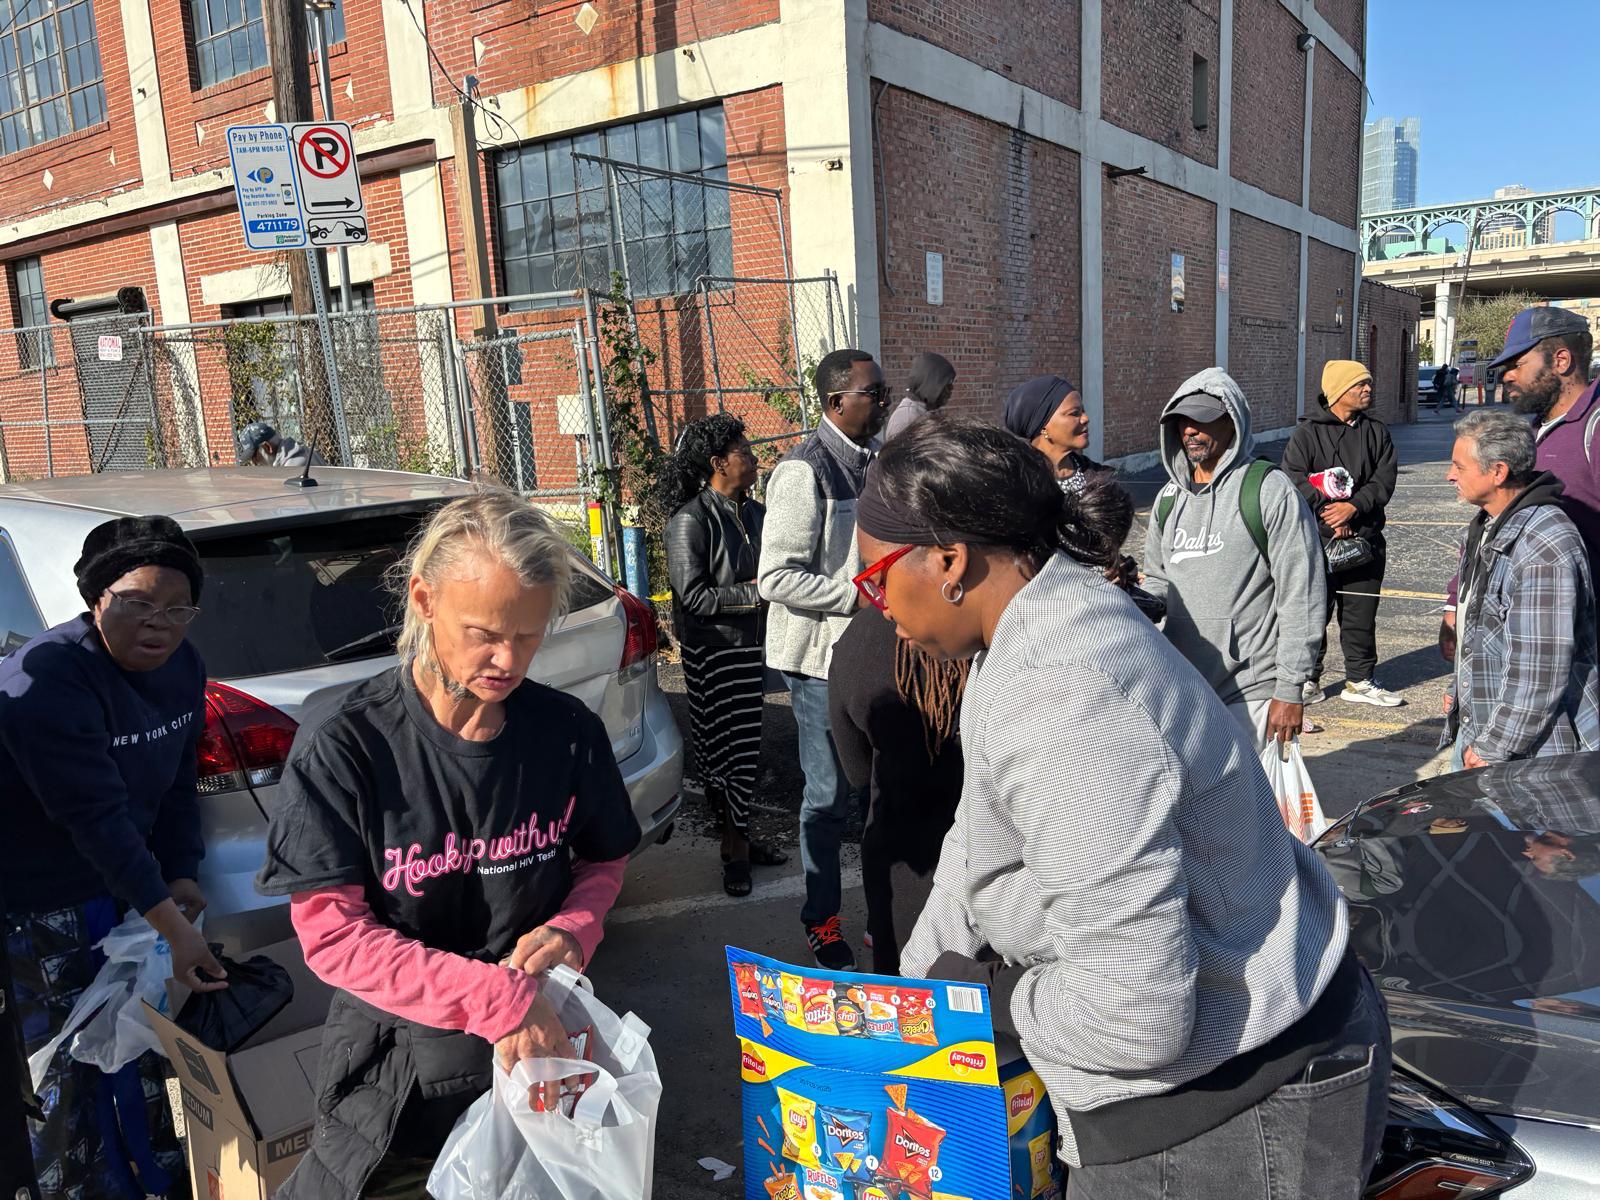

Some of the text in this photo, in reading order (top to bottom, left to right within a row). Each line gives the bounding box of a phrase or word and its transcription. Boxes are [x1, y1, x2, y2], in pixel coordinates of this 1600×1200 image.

[233, 131, 282, 142] Pay by Phone
[257, 220, 298, 230] 471179
[113, 712, 193, 746] NEW YORK CITY
[489, 811, 547, 861] with
[477, 847, 557, 875] National HIV Testi
[805, 1003, 832, 1023] Fritos
[902, 1020, 930, 1034] Cheetos
[827, 1126, 865, 1140] Doritos
[896, 1134, 931, 1157] Doritos
[931, 1169, 939, 1178] 12
